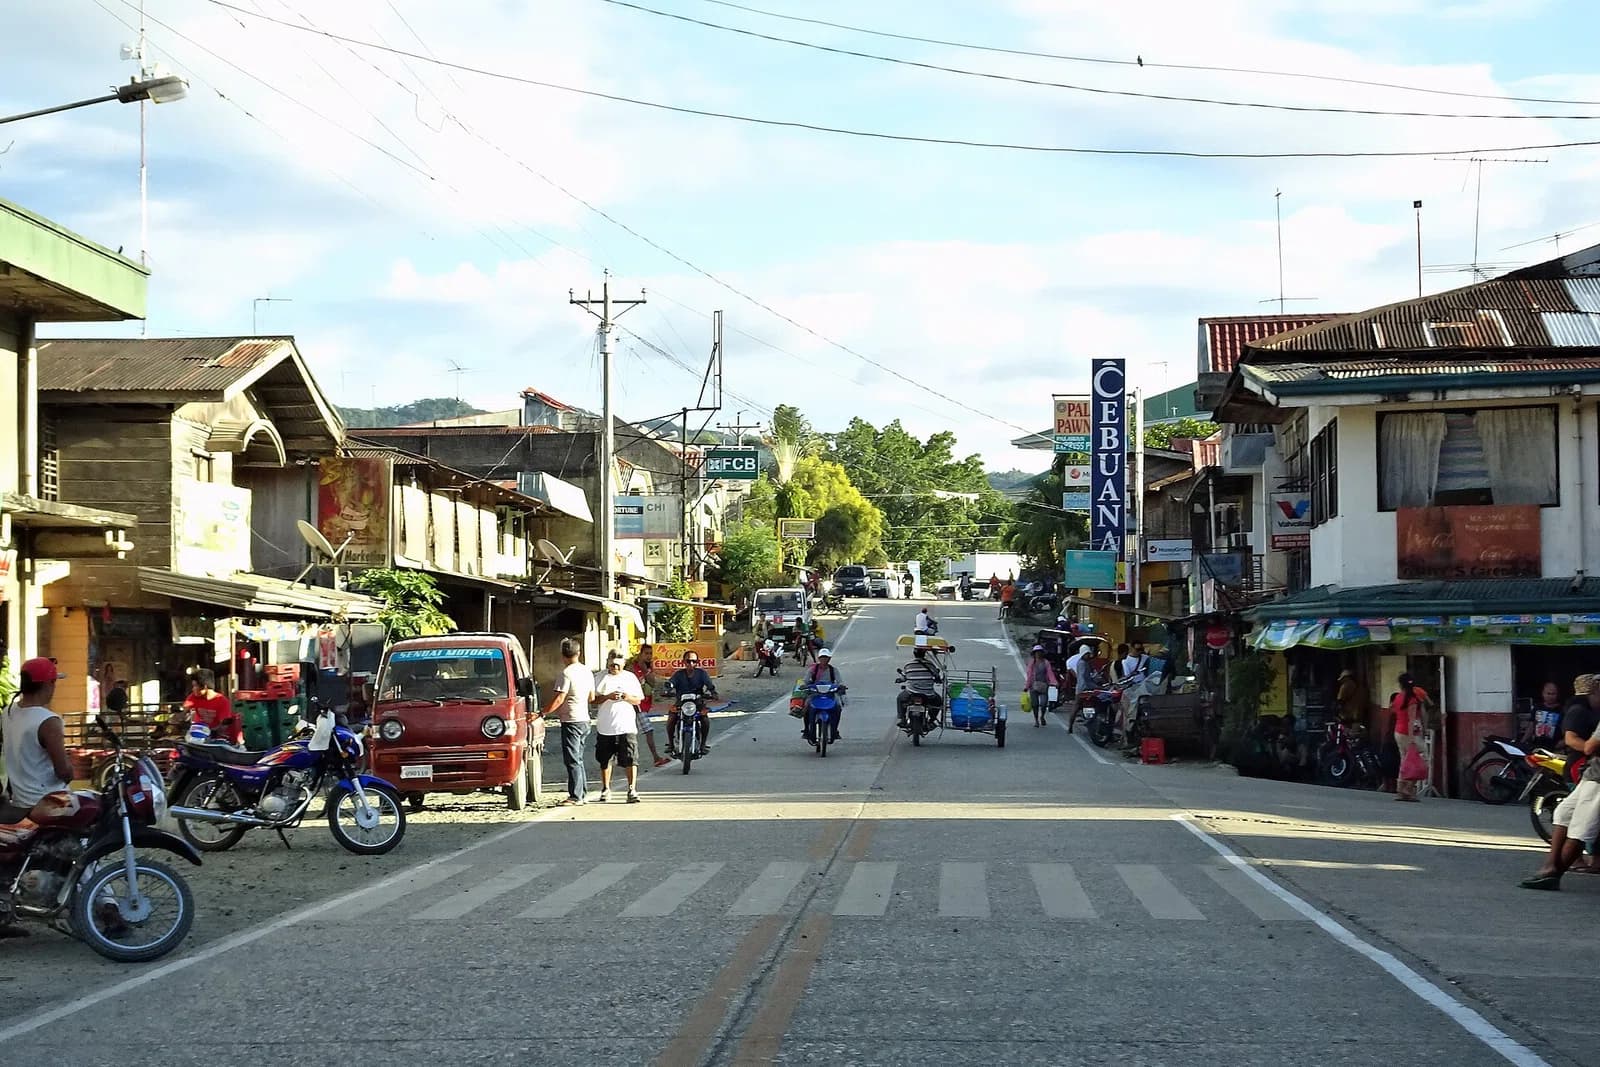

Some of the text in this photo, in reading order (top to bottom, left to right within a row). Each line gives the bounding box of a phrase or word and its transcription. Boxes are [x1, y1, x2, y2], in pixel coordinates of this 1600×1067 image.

[1093, 361, 1124, 552] CEBUANA
[722, 458, 756, 470] FCB
[400, 648, 494, 658] SENDAI MOTORS
